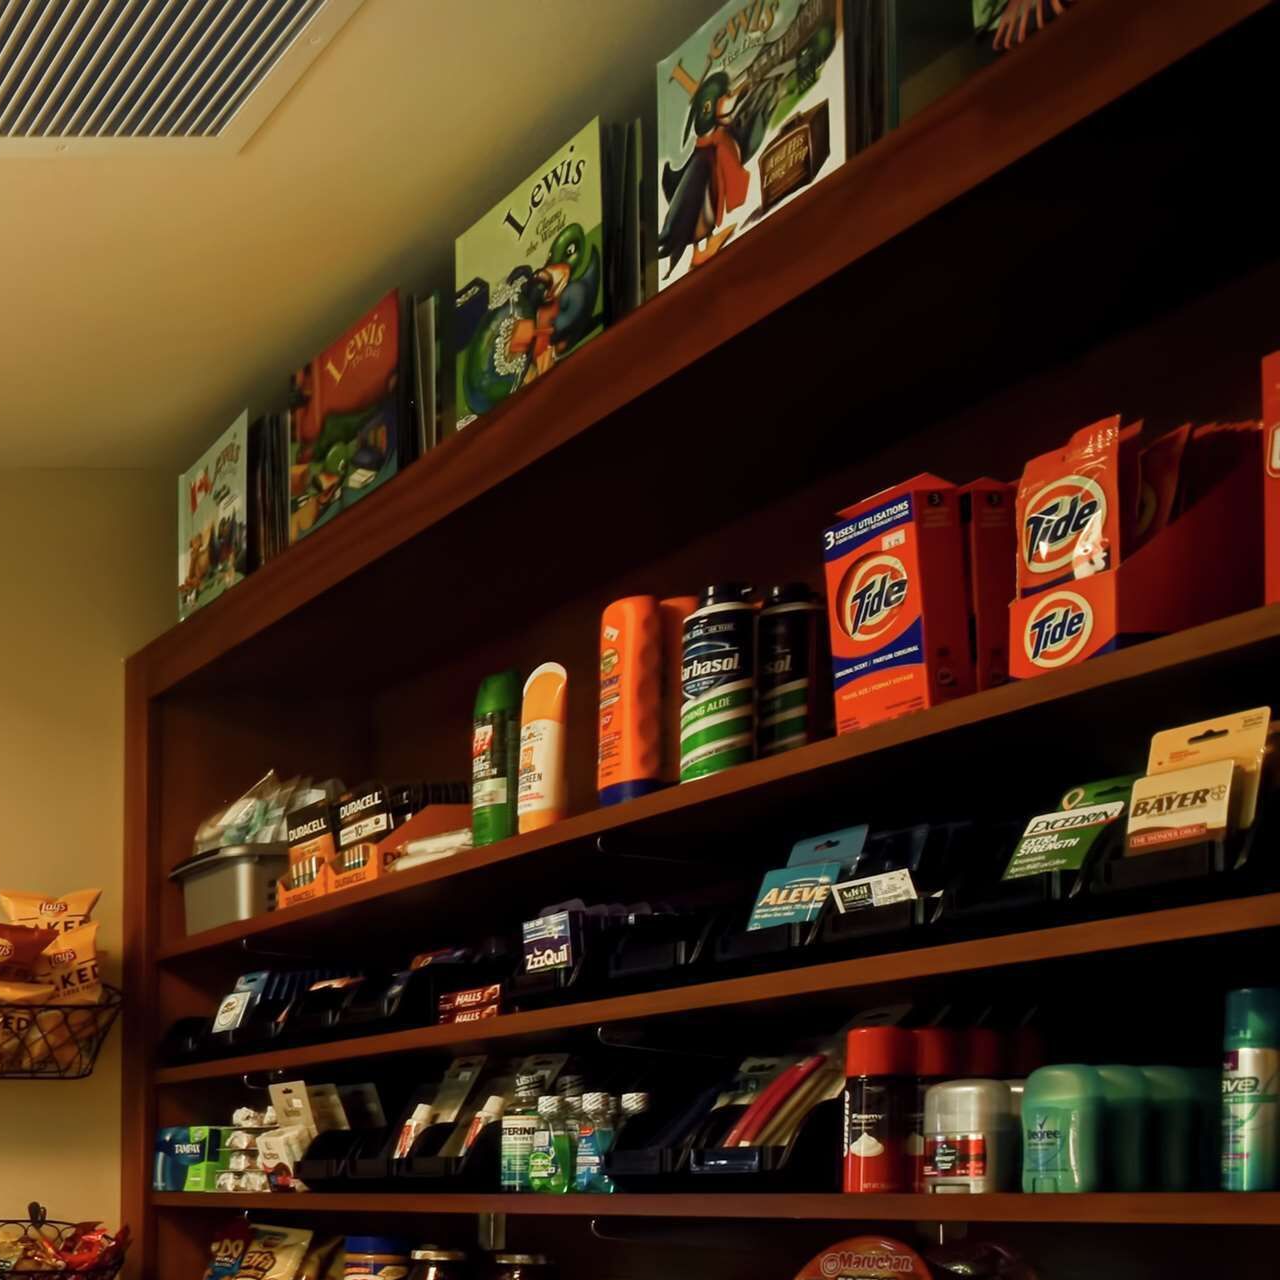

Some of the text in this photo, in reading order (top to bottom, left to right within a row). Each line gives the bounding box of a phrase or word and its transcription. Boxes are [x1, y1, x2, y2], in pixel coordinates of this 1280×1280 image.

[502, 145, 587, 240] Lewis
[325, 313, 385, 383] Lewis
[824, 531, 835, 550] 3
[857, 501, 910, 529] UTILISATIONS
[1024, 495, 1102, 564] Tide
[851, 571, 908, 637] Tide
[1030, 609, 1086, 664] Tide
[340, 791, 384, 819] DURACELL
[1131, 787, 1211, 818] BAYER
[289, 817, 327, 842] DURACELL
[1028, 808, 1117, 834] EXCEDRIN
[1018, 837, 1080, 857] STRENGTH
[1022, 834, 1058, 849] EXTRA
[759, 885, 831, 907] ALEVE
[526, 944, 568, 970] ZzzQuil
[457, 991, 481, 1004] HALLS
[456, 1010, 480, 1023] HALLS
[174, 1143, 201, 1157] TAMPAX
[840, 1252, 913, 1274] Maruchan
